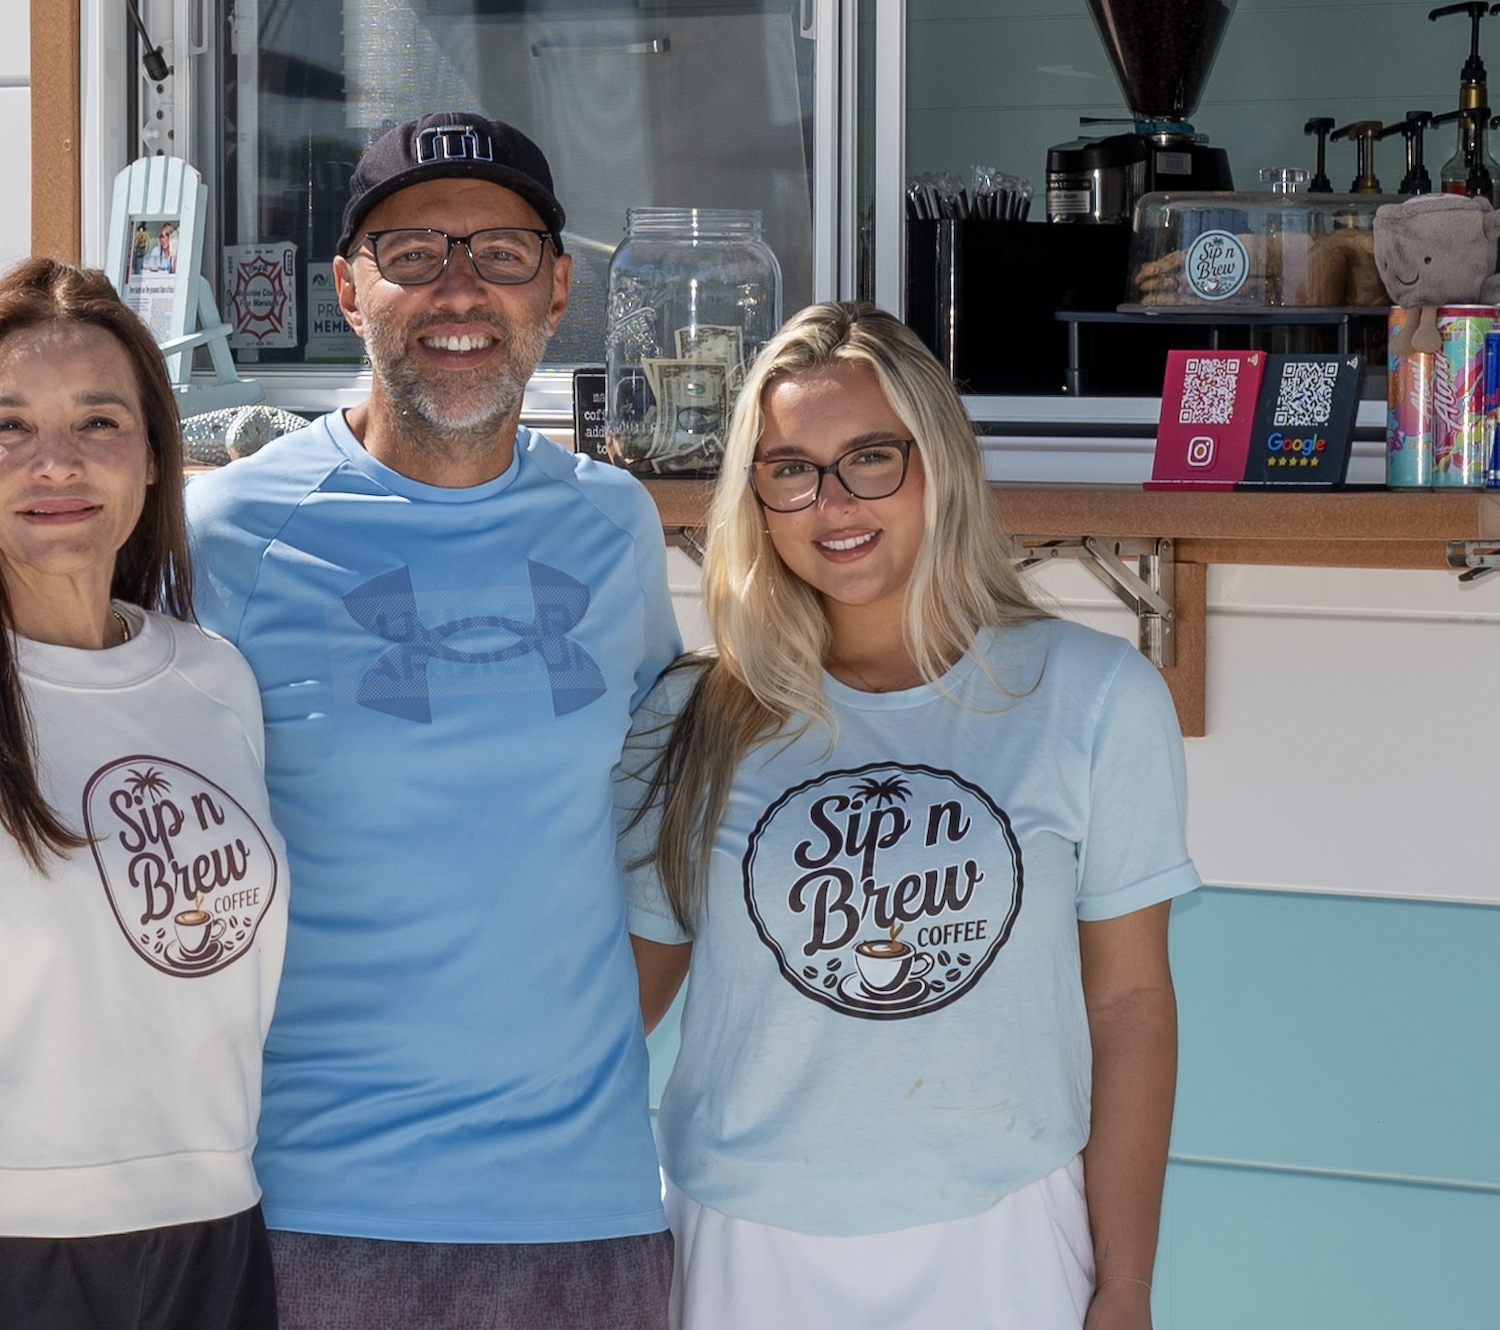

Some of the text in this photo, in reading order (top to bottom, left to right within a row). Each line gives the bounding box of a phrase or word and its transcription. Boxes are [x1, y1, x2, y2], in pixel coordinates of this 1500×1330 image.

[1199, 241, 1235, 263] Sip n
[1197, 261, 1236, 280] Brew
[318, 304, 343, 317] PRO
[314, 320, 353, 333] MEMB
[1485, 387, 1499, 405] ed
[1267, 432, 1327, 455] Google
[109, 789, 224, 864] Sip n
[794, 795, 971, 882] Sip n
[128, 838, 250, 925] Brew
[215, 887, 260, 914] COFFEE
[788, 860, 984, 957] Brew
[917, 920, 987, 947] COFFEE
